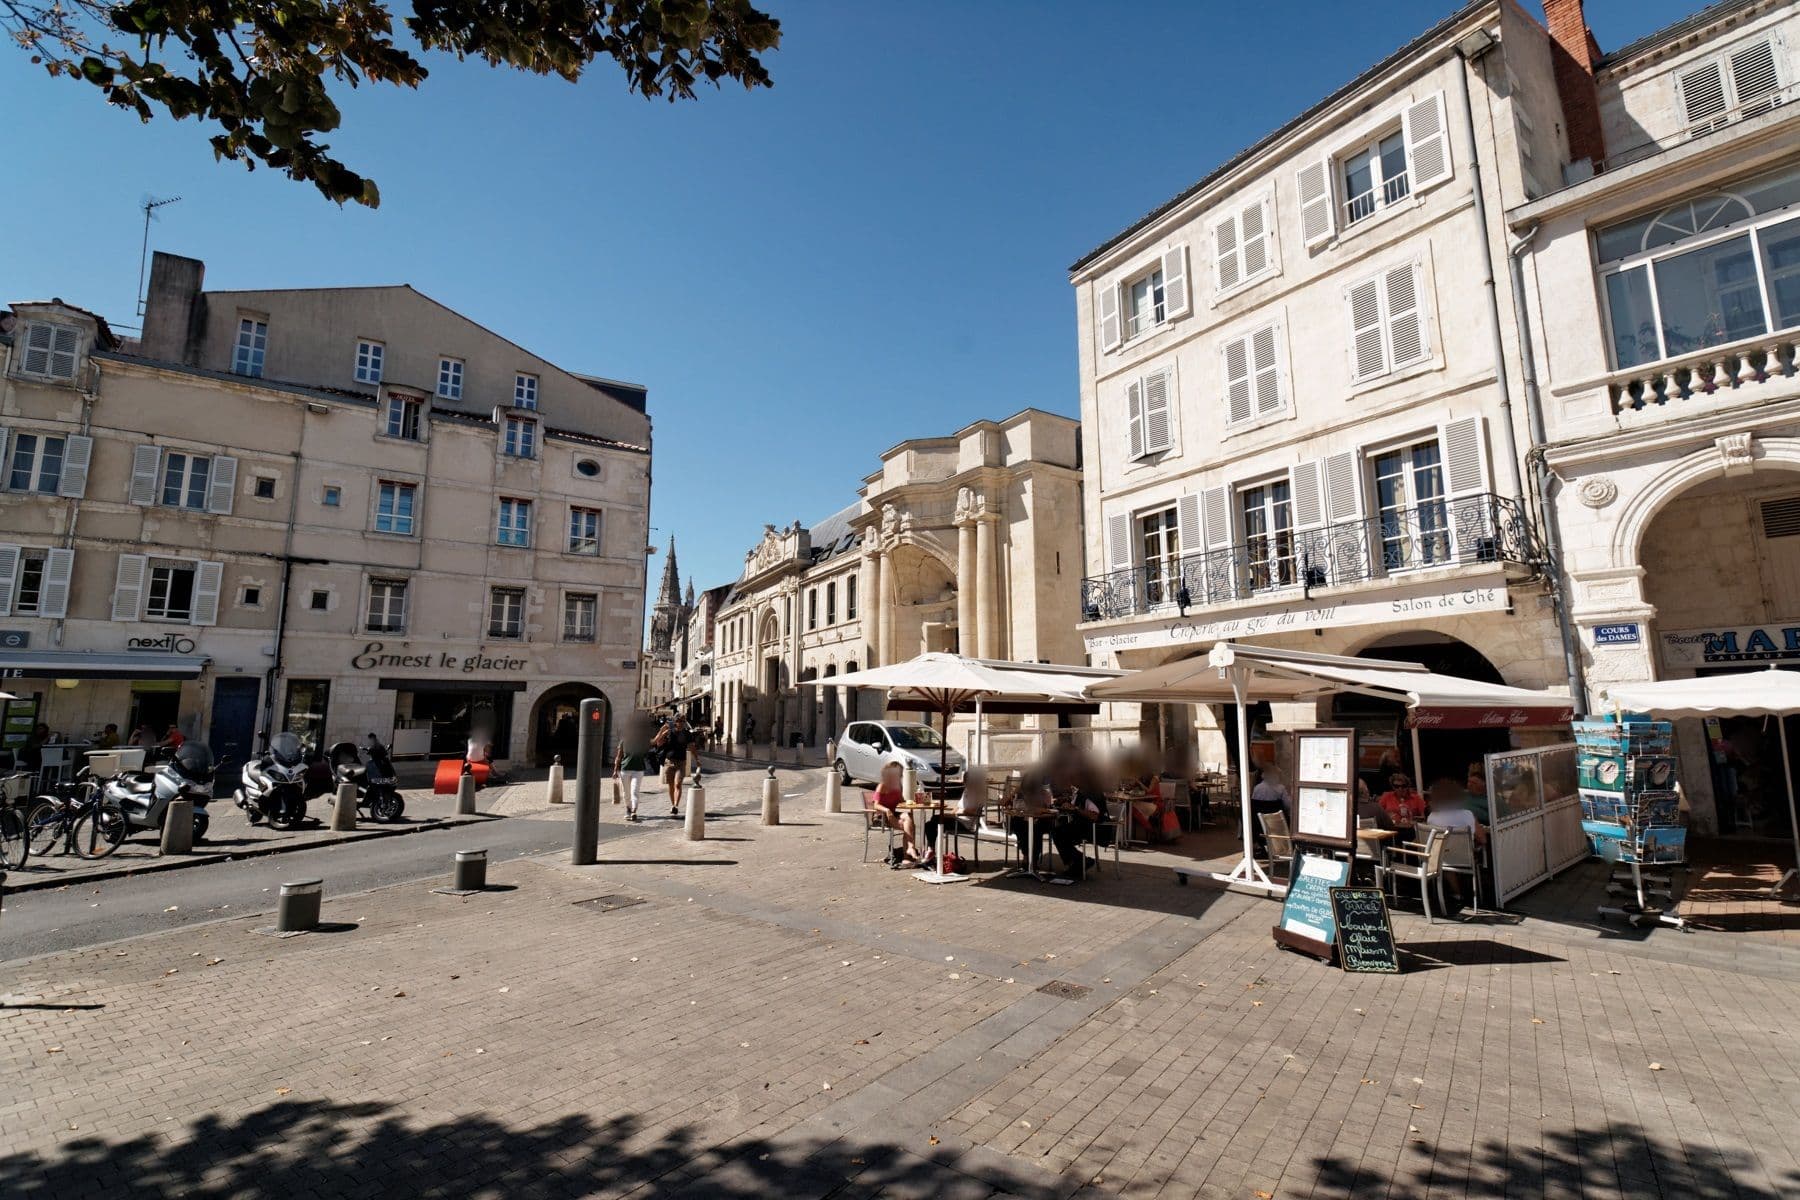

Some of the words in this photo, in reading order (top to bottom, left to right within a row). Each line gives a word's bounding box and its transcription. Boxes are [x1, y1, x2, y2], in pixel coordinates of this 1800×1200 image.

[1392, 598, 1432, 613] Salon
[1439, 594, 1455, 607] de
[1462, 588, 1495, 605] Thé
[1223, 621, 1239, 632] au
[1277, 608, 1295, 625] du
[1601, 626, 1629, 634] COURS
[1608, 633, 1637, 641] DAMES
[1089, 637, 1103, 648] Bar
[1109, 634, 1138, 646] Glacier
[352, 642, 432, 669] Ernest
[440, 652, 457, 669] le
[462, 654, 527, 673] glacier
[1708, 653, 1783, 661] CADEAUX
